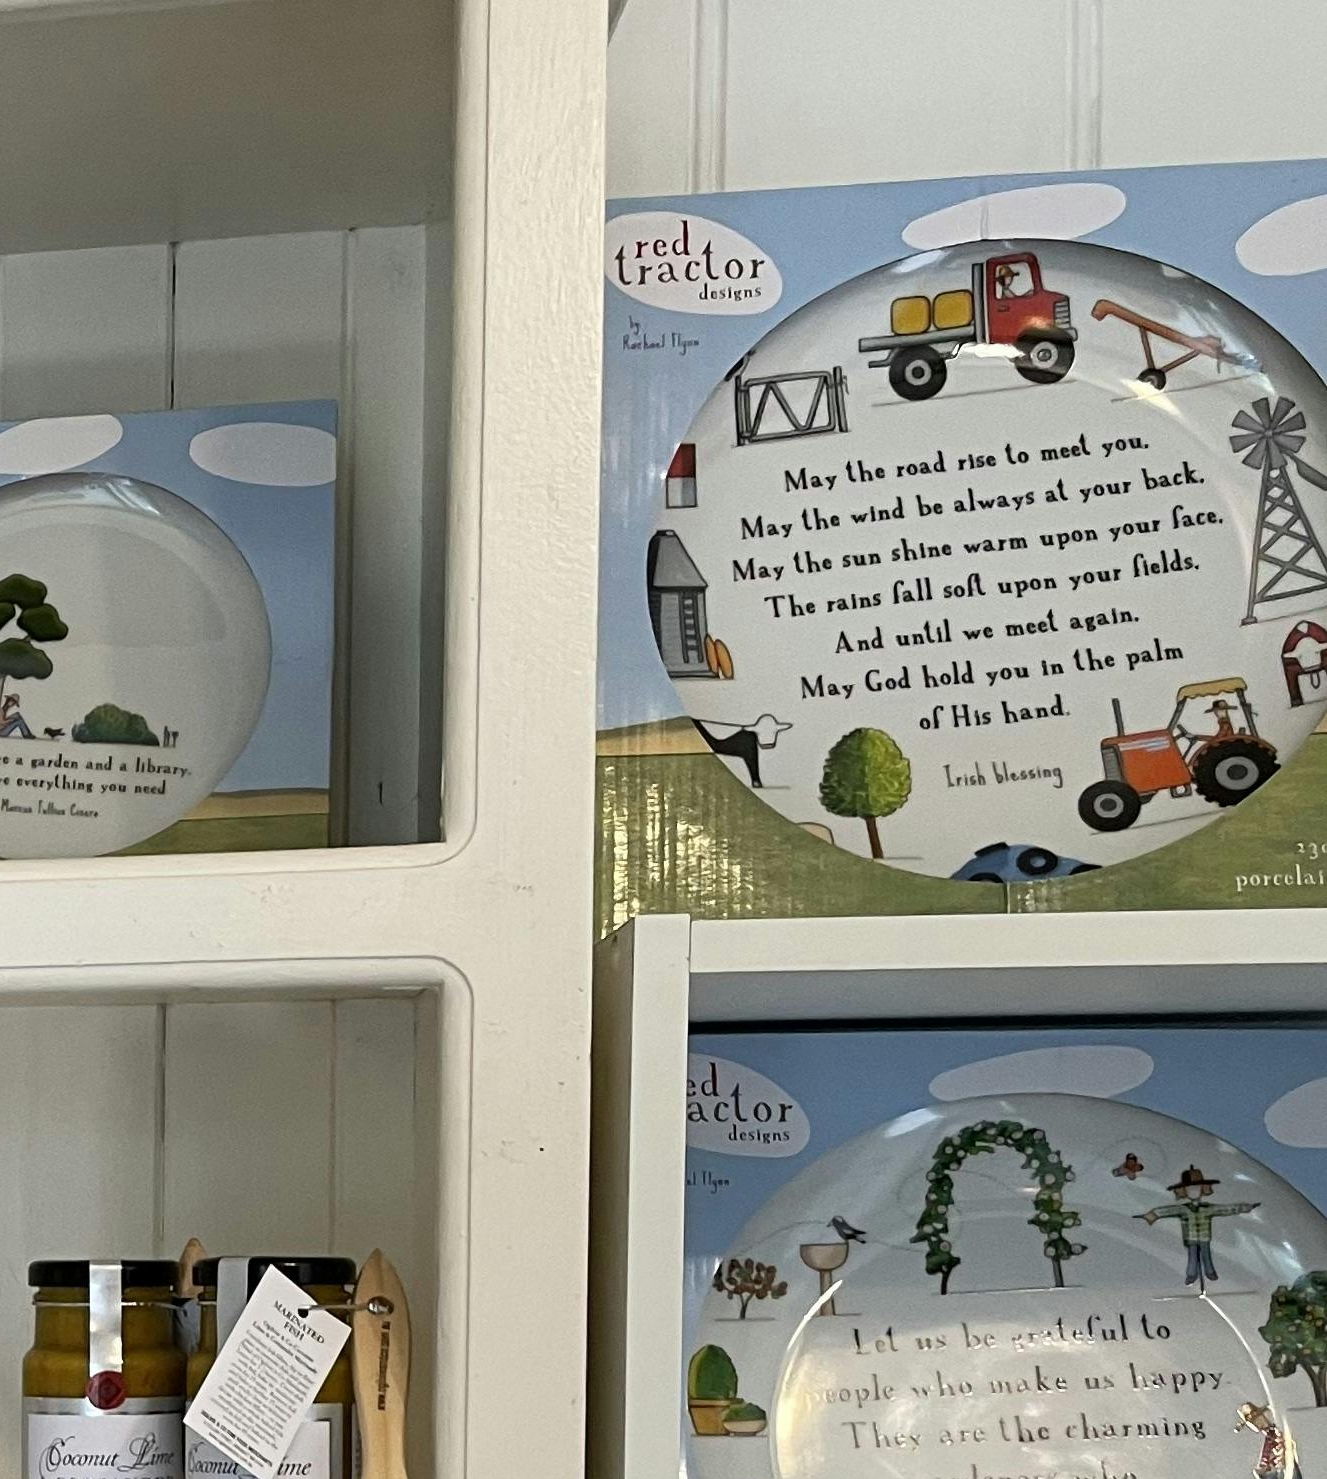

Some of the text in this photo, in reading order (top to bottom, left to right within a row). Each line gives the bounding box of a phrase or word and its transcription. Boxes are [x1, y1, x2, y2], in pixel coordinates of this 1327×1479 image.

[635, 220, 690, 258] red
[615, 240, 765, 285] tractor
[699, 283, 761, 301] designs
[784, 468, 837, 492] May
[846, 461, 885, 483] the
[896, 451, 946, 477] road
[958, 454, 997, 471] rise
[1005, 443, 1029, 465] to
[1041, 433, 1091, 461] meet
[741, 515, 793, 540] May
[801, 508, 840, 531] the
[851, 496, 905, 523] wind
[916, 495, 943, 517] be
[954, 488, 1035, 511] always
[1045, 479, 1068, 503] at
[1079, 481, 1131, 503] your
[733, 558, 784, 582] May
[793, 551, 833, 574] the
[842, 553, 881, 568] sun
[891, 538, 952, 562] shine
[963, 536, 1028, 555] warm
[1040, 529, 1098, 550] upon
[1109, 520, 1160, 542] your
[764, 595, 816, 618] The
[827, 592, 882, 613] rains
[893, 577, 933, 604] fall
[943, 573, 986, 598] soft
[998, 576, 1057, 598] upon
[1069, 568, 1121, 590] your
[835, 626, 884, 653] And
[896, 619, 952, 646] until
[962, 626, 993, 640] we
[1006, 609, 1058, 637] meet
[801, 638, 1184, 699] May God hold you in the palm
[919, 704, 942, 730] of
[952, 703, 992, 728] His
[16, 758, 23, 766] a
[31, 754, 78, 770] garden
[86, 756, 112, 772] and
[119, 763, 127, 772] a
[943, 760, 1063, 788] Irish blessing
[17, 775, 93, 792] everything
[101, 784, 126, 794] you
[134, 780, 165, 794] need
[842, 1412, 1207, 1452] They are the charming
[39, 1436, 120, 1472] Coconut
[117, 1433, 175, 1472] Lime
